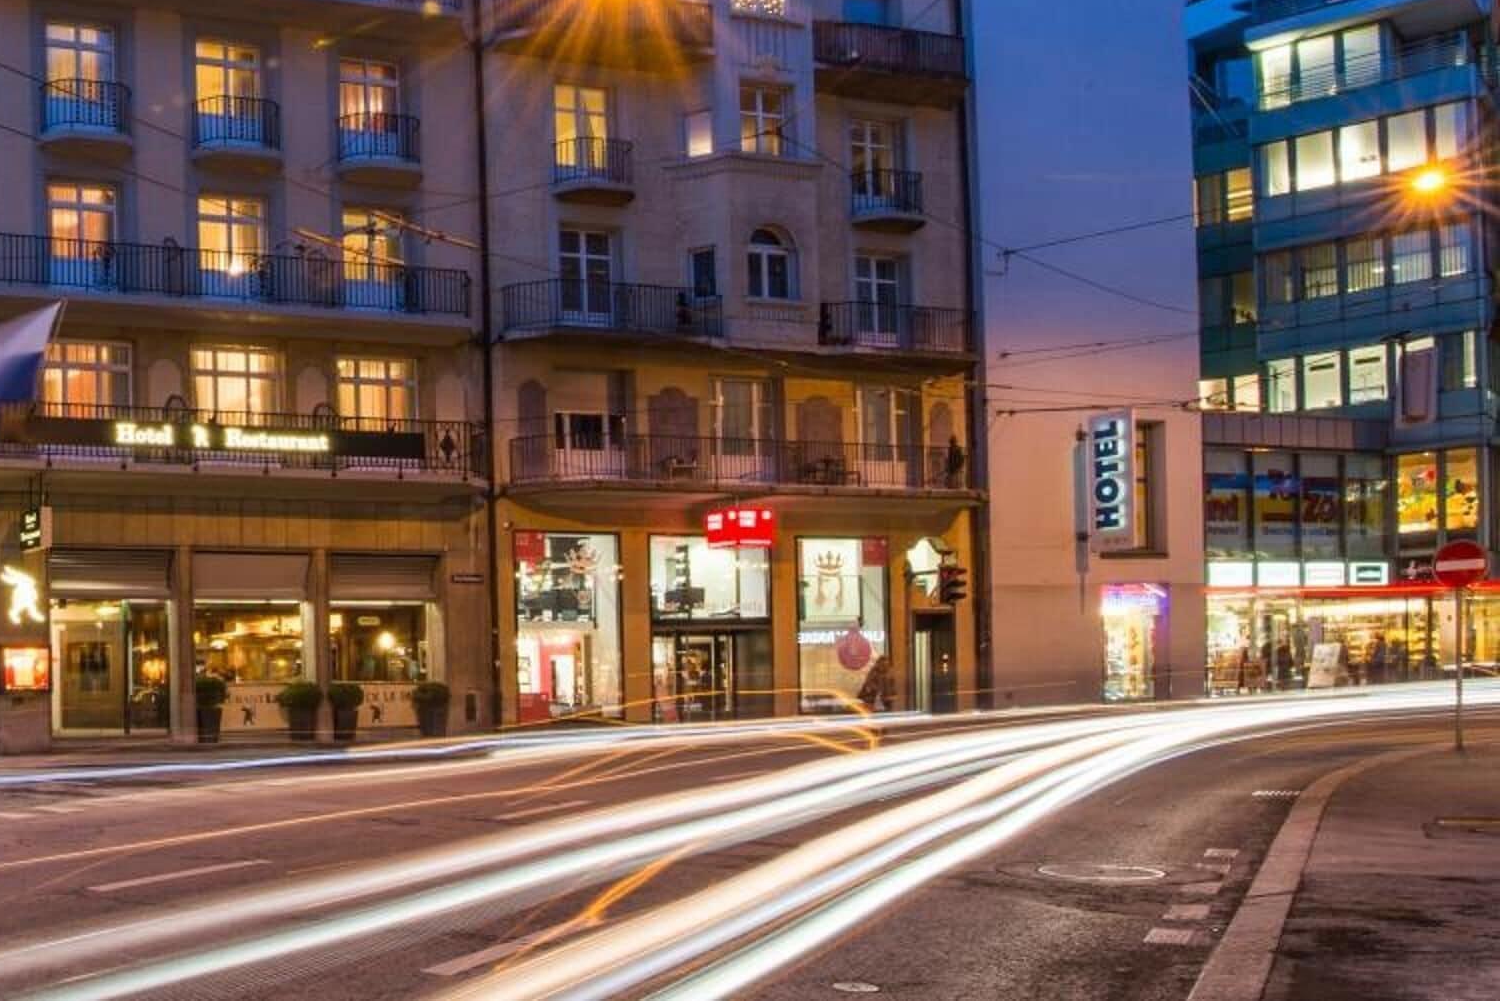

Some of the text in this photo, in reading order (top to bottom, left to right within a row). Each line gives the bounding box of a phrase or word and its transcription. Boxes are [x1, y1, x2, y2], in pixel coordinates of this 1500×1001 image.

[115, 423, 330, 451] Hotel Restaurant
[1093, 420, 1122, 530] HOTEL
